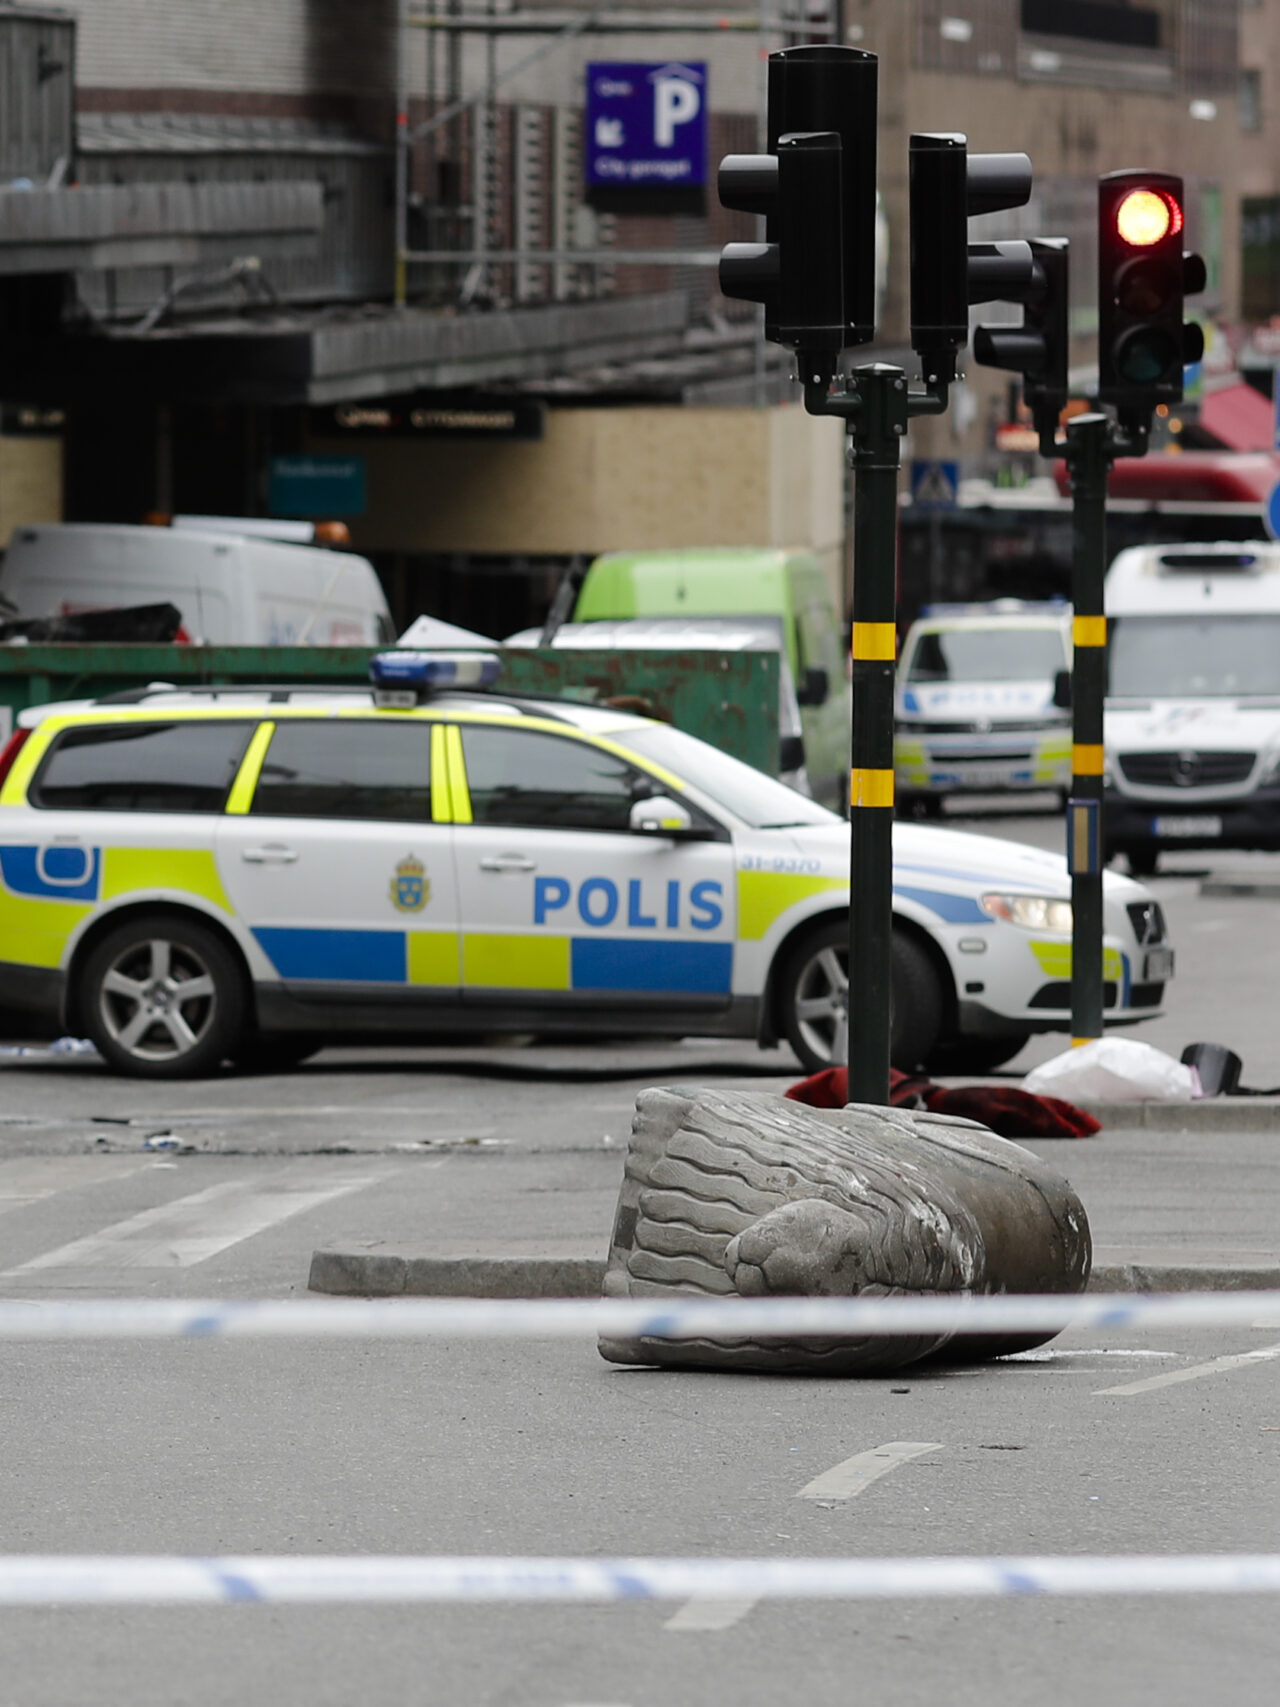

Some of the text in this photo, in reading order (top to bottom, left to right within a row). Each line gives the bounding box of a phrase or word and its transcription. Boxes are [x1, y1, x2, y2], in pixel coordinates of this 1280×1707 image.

[654, 77, 700, 148] P
[741, 854, 821, 873] 31-9370
[533, 876, 724, 931] POLIS
